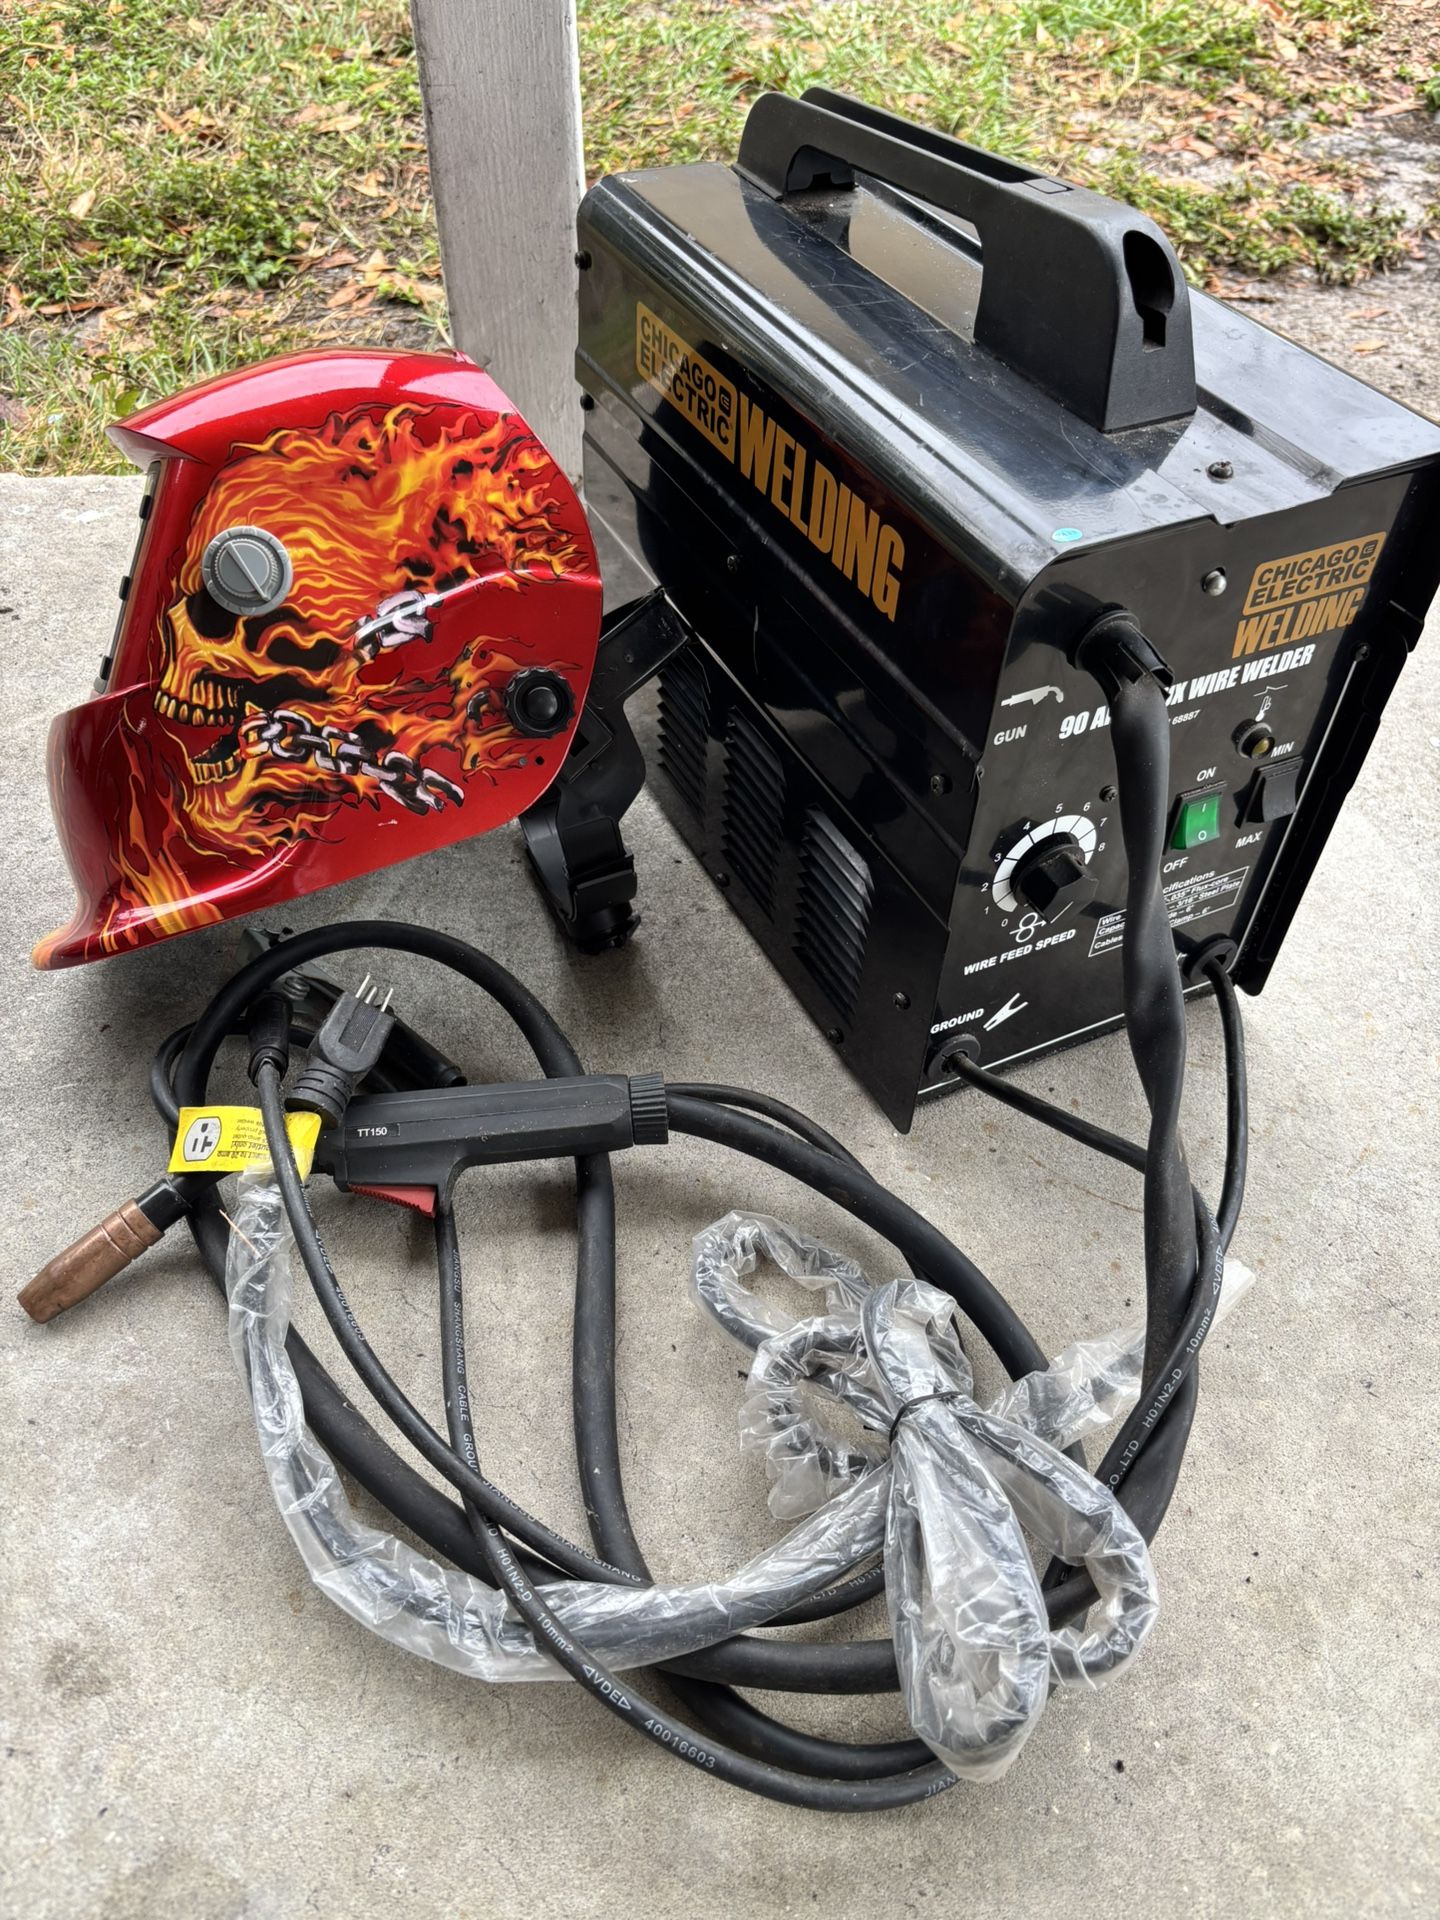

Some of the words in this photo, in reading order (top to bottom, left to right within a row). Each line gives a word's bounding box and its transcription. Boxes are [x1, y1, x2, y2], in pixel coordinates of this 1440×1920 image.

[640, 315, 717, 398] CHICAGO
[640, 346, 733, 446] ELECTRIC
[739, 390, 905, 623] WELDING
[1257, 545, 1361, 586] CHICAGO
[1249, 560, 1370, 608] ELECTRIC
[1231, 586, 1366, 659] WELDING
[1059, 711, 1090, 739] 90
[1188, 665, 1242, 700] WIRE
[1240, 643, 1317, 685] WELDER
[993, 724, 1028, 746] GUN
[1270, 741, 1295, 758] MIN
[1196, 766, 1217, 782] ON
[1055, 803, 1064, 813] 5
[1083, 802, 1091, 812] 6
[1023, 822, 1031, 831] 4
[1100, 817, 1108, 827] 7
[1098, 842, 1106, 852] 8
[1235, 831, 1263, 849] MAX
[994, 853, 1002, 863] 3
[1163, 856, 1190, 873] OFF
[980, 882, 989, 892] 2
[1162, 870, 1215, 894] cifications
[1001, 918, 1009, 927] 0
[963, 955, 997, 976] WIRE
[999, 944, 1033, 964] FEED
[1035, 928, 1077, 951] SPEED
[930, 1008, 985, 1034] GROUND
[357, 1126, 388, 1138] TT150
[454, 1301, 466, 1375] SHANGSHANG
[457, 1384, 470, 1422] CABLE
[1142, 1367, 1183, 1430] H01N2-D
[463, 1433, 479, 1473] GROU
[496, 1548, 533, 1602] H01N2-D
[644, 1718, 716, 1769] 40016603
